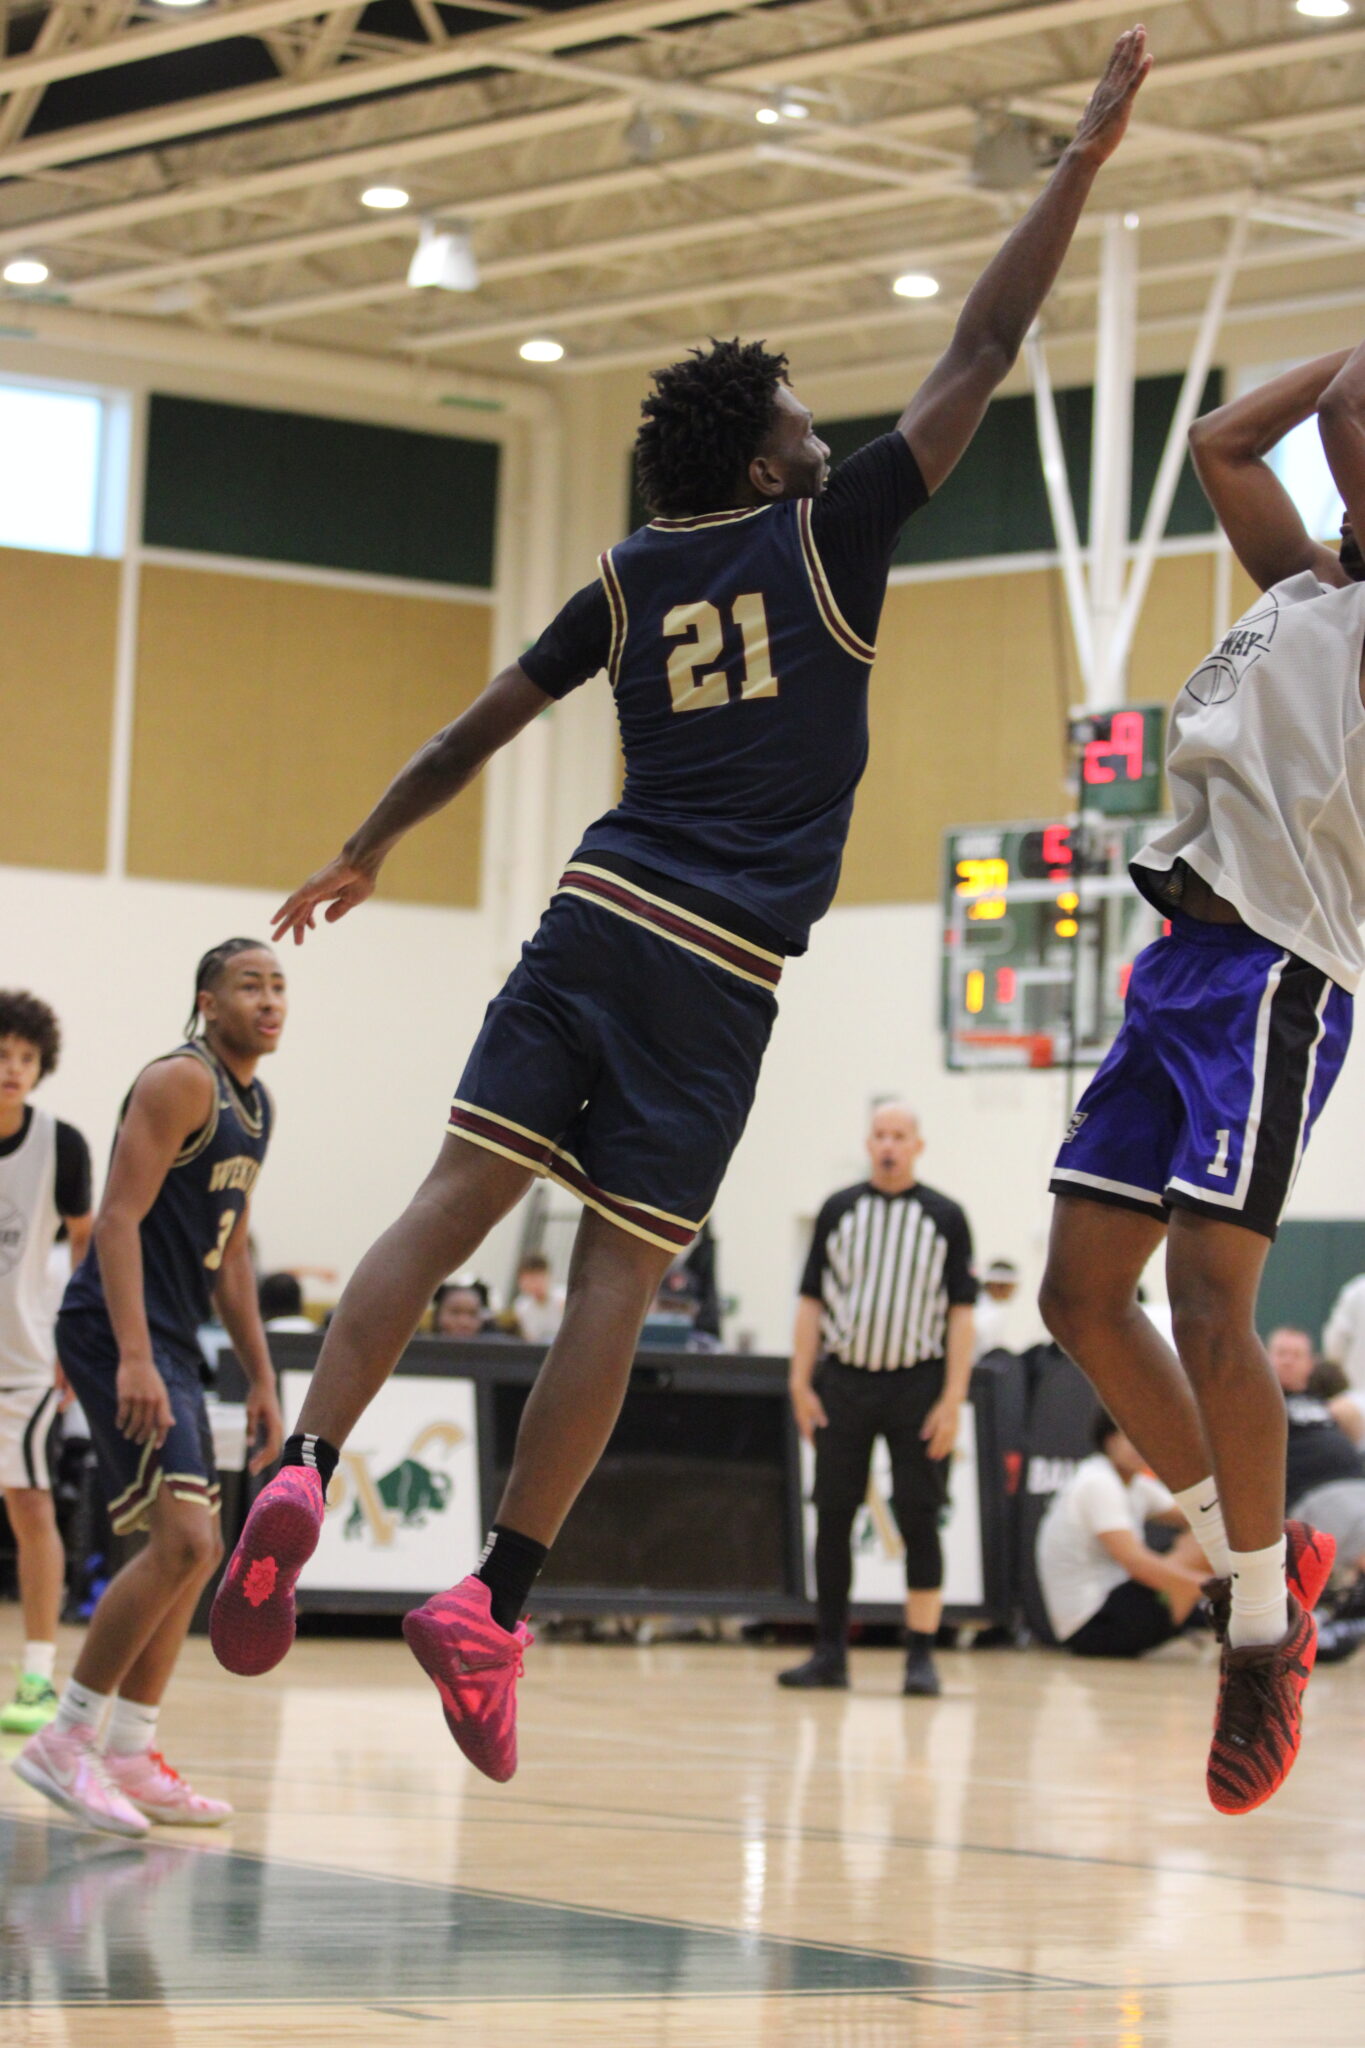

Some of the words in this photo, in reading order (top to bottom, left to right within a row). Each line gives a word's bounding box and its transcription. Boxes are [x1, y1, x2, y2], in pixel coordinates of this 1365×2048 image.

[662, 591, 778, 713] 21
[1206, 1129, 1231, 1178] 1
[203, 1208, 237, 1271] 3
